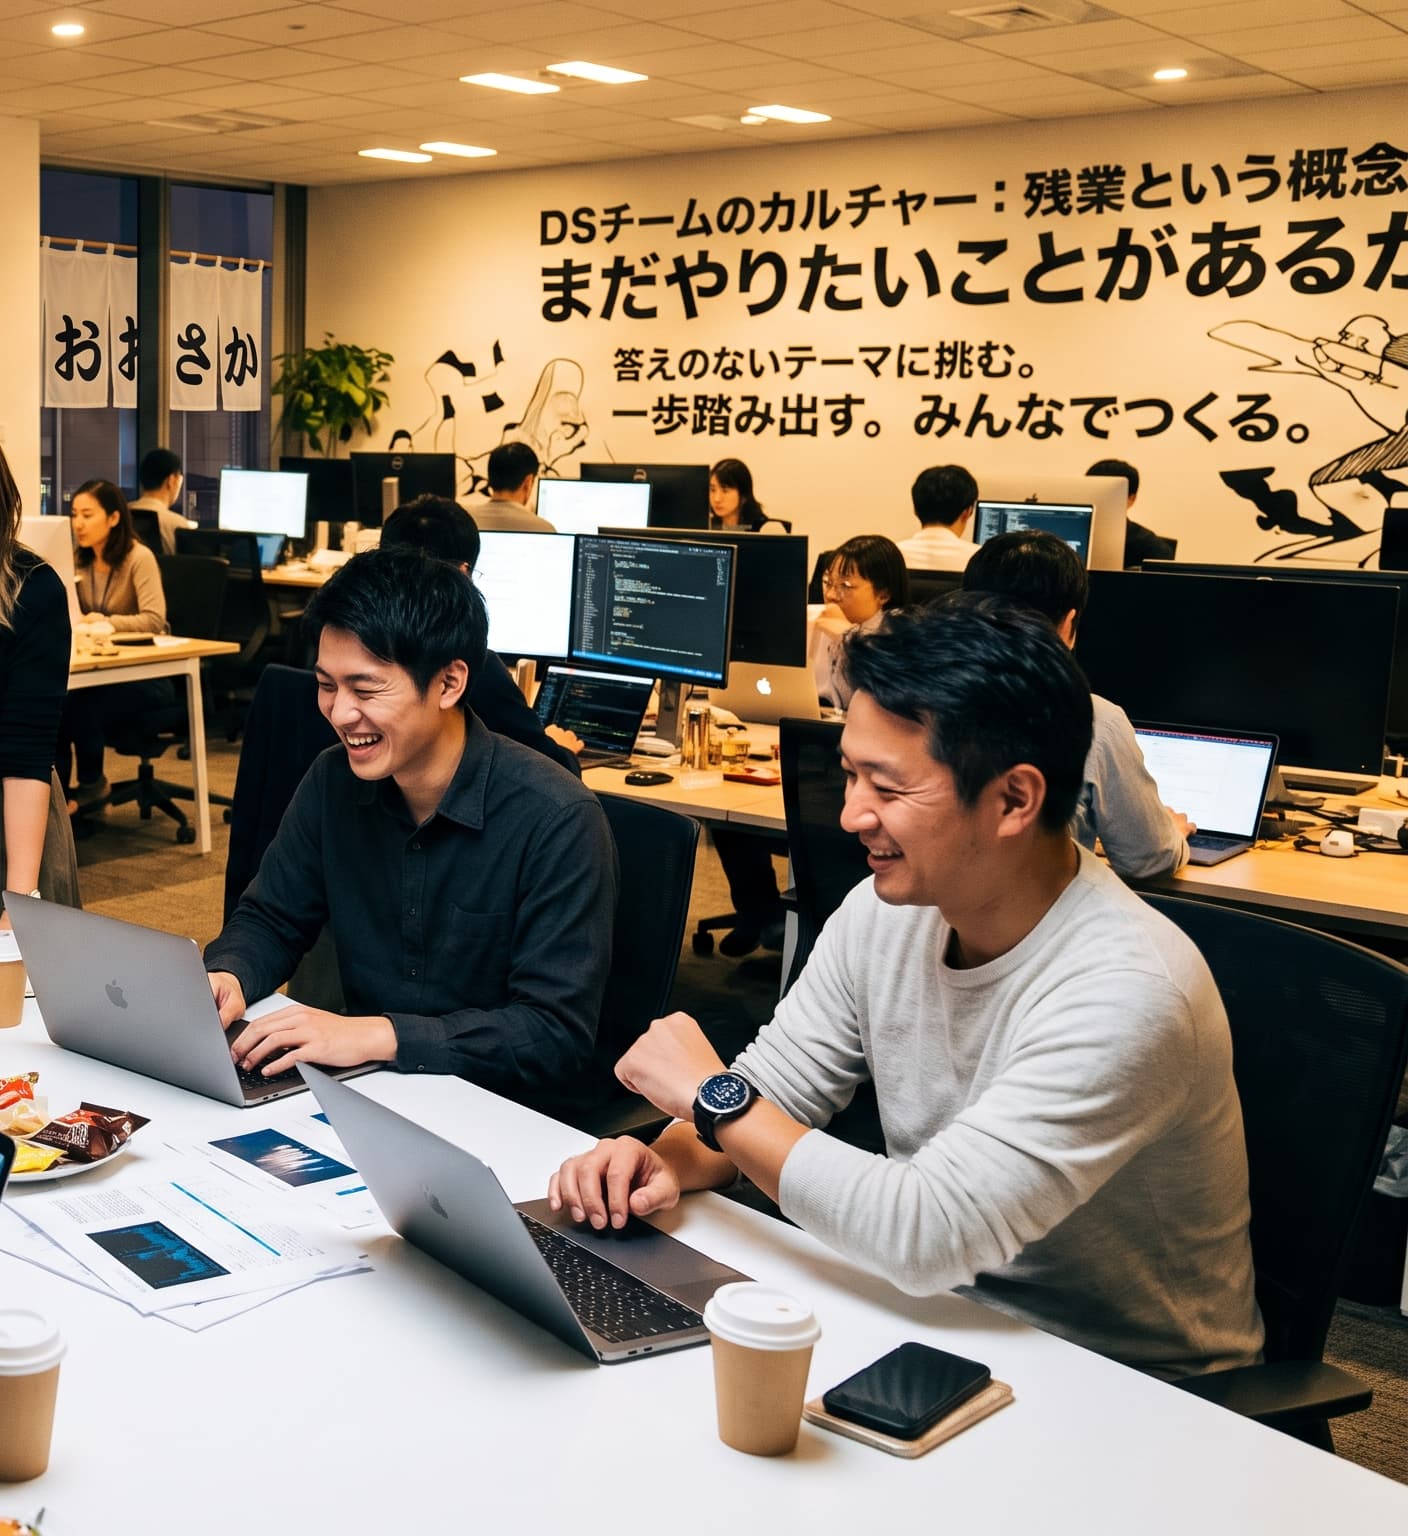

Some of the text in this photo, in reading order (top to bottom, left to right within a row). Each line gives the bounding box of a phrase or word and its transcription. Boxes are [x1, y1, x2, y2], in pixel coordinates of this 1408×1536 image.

[613, 340, 1034, 382] 答えのないテーマに挑む。
